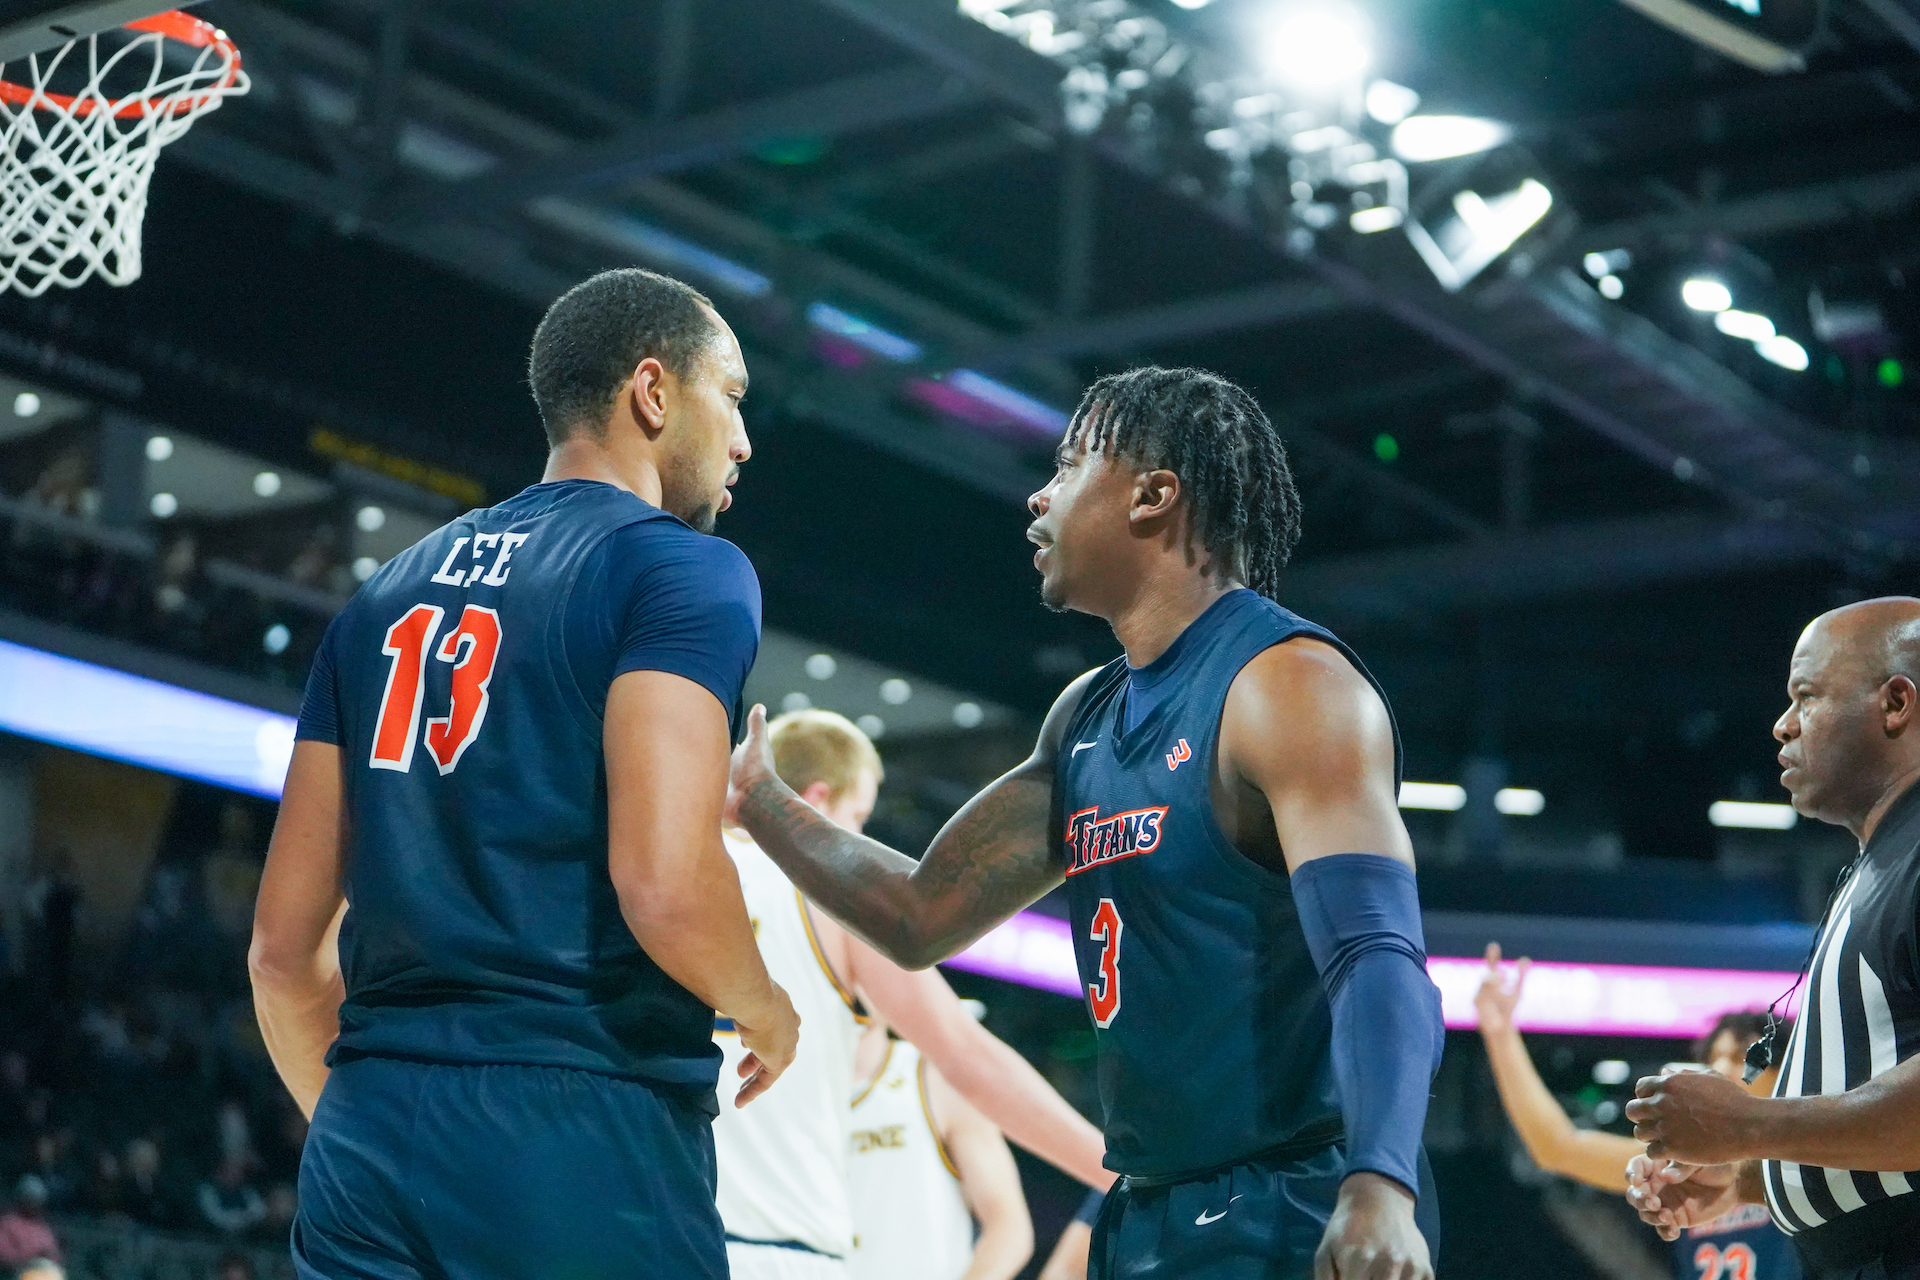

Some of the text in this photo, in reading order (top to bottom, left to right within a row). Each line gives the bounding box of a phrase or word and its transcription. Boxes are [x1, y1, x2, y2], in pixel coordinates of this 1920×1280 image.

[430, 532, 530, 588] LEE
[369, 603, 503, 777] 13
[1065, 805, 1170, 877] TITANS
[1088, 897, 1124, 1030] 3
